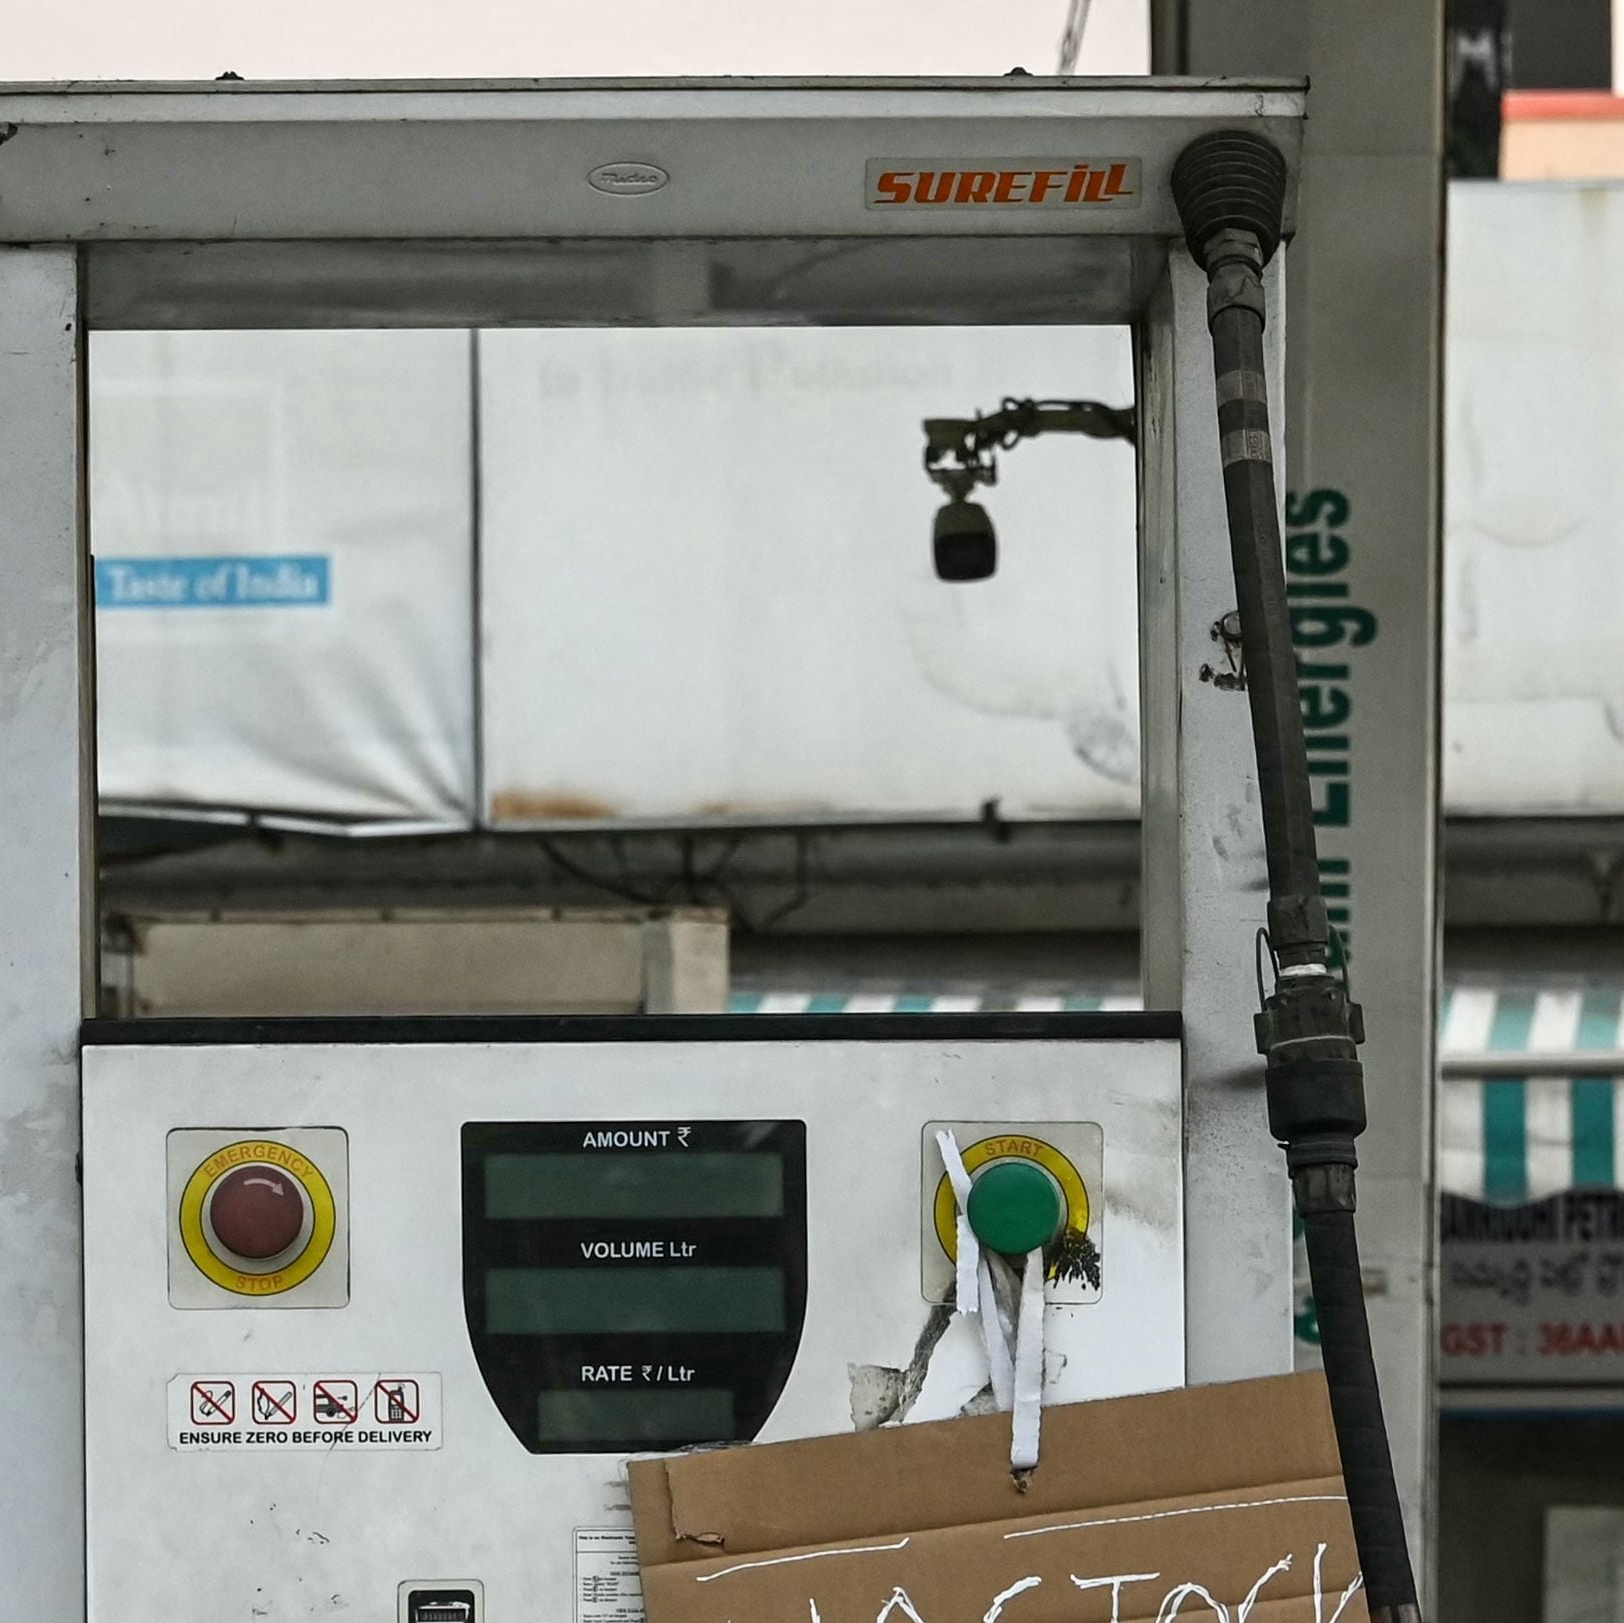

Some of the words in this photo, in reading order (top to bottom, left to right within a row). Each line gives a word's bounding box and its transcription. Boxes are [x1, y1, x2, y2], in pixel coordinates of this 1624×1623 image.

[582, 1130, 671, 1148] AMOUNT
[984, 1141, 1043, 1157] START
[203, 1145, 314, 1178] EMERGENCY
[580, 1242, 664, 1258] VOLUME
[670, 1241, 697, 1257] Ltr
[235, 1274, 284, 1291] STOP
[581, 1366, 633, 1382] RATE
[179, 1431, 242, 1444] ENSURE
[246, 1431, 288, 1444] ZERO
[292, 1431, 354, 1443] BEFORE
[358, 1430, 433, 1443] DELIVERY
